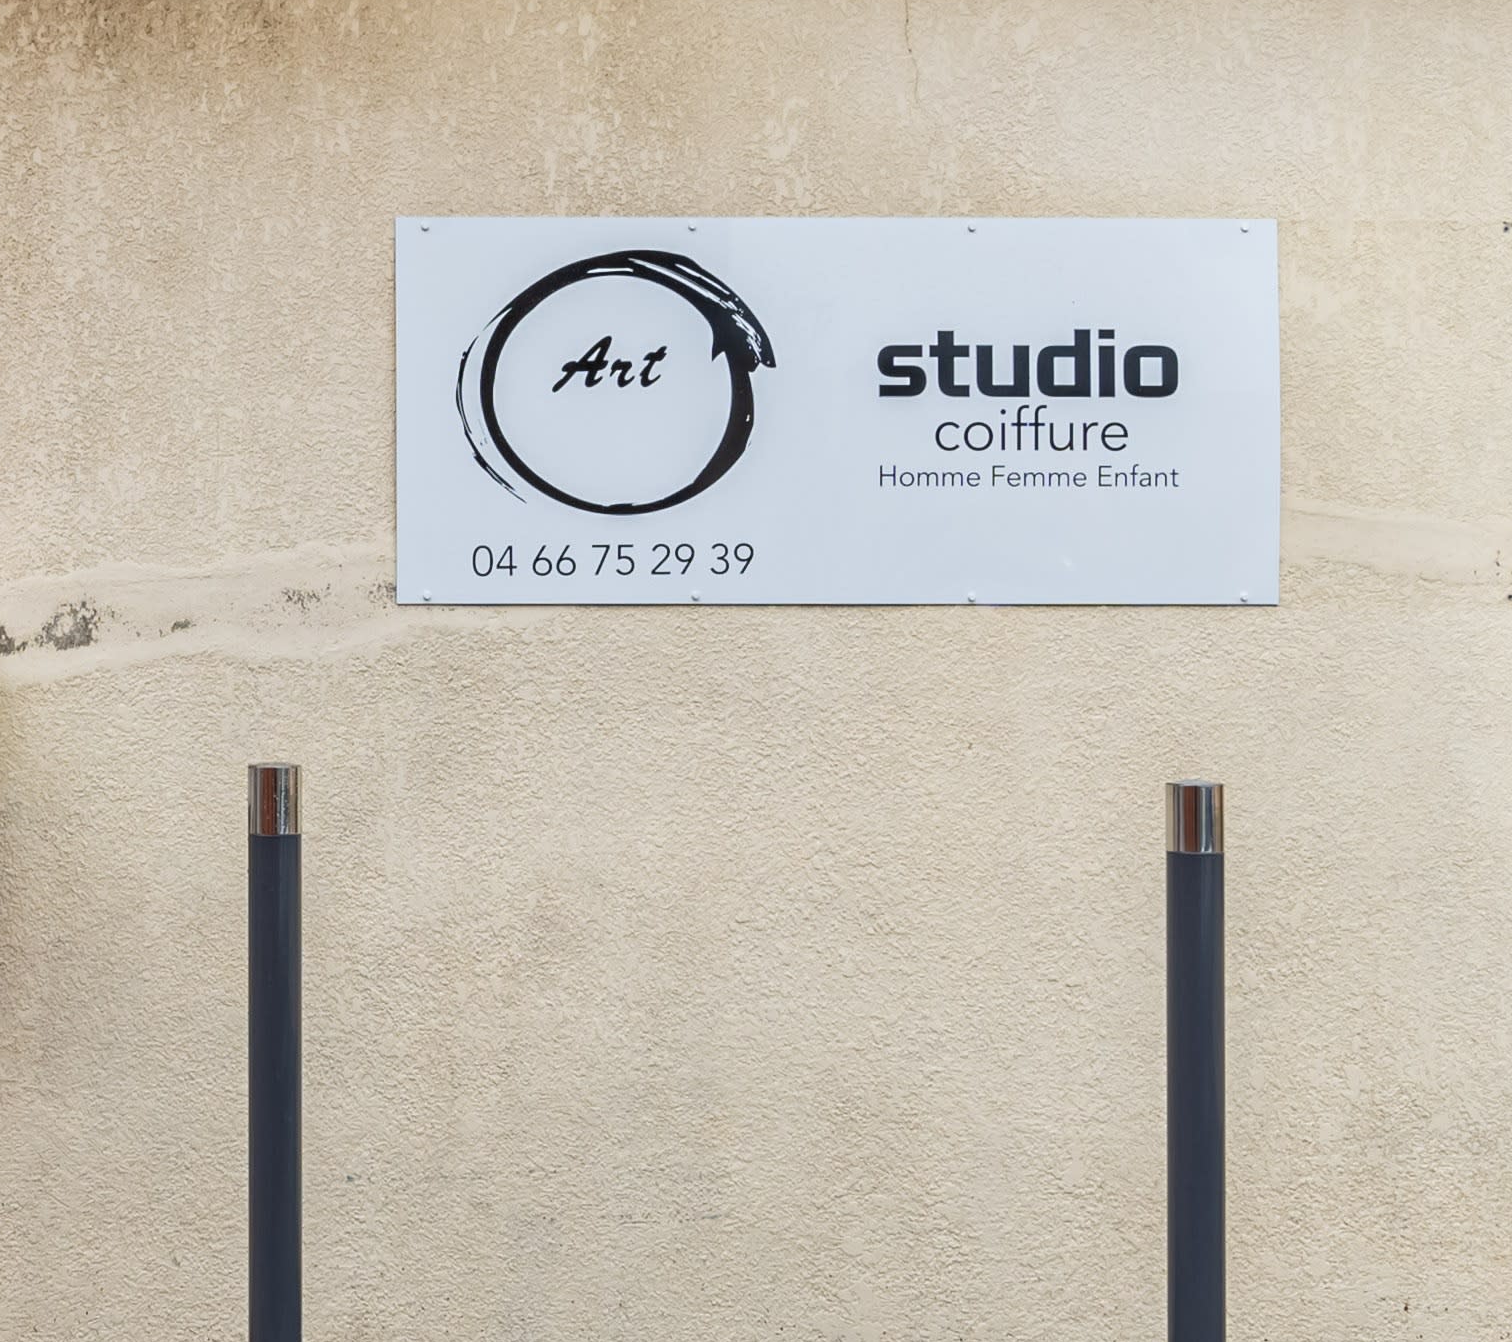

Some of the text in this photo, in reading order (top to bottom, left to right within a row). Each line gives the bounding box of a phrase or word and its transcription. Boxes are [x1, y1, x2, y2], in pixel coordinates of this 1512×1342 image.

[552, 334, 668, 393] Art
[878, 329, 1179, 398] studio
[934, 405, 1130, 452] coiffure
[879, 464, 1180, 488] Homme Femme Enfant
[472, 543, 755, 577] 04 66 75 29 39
